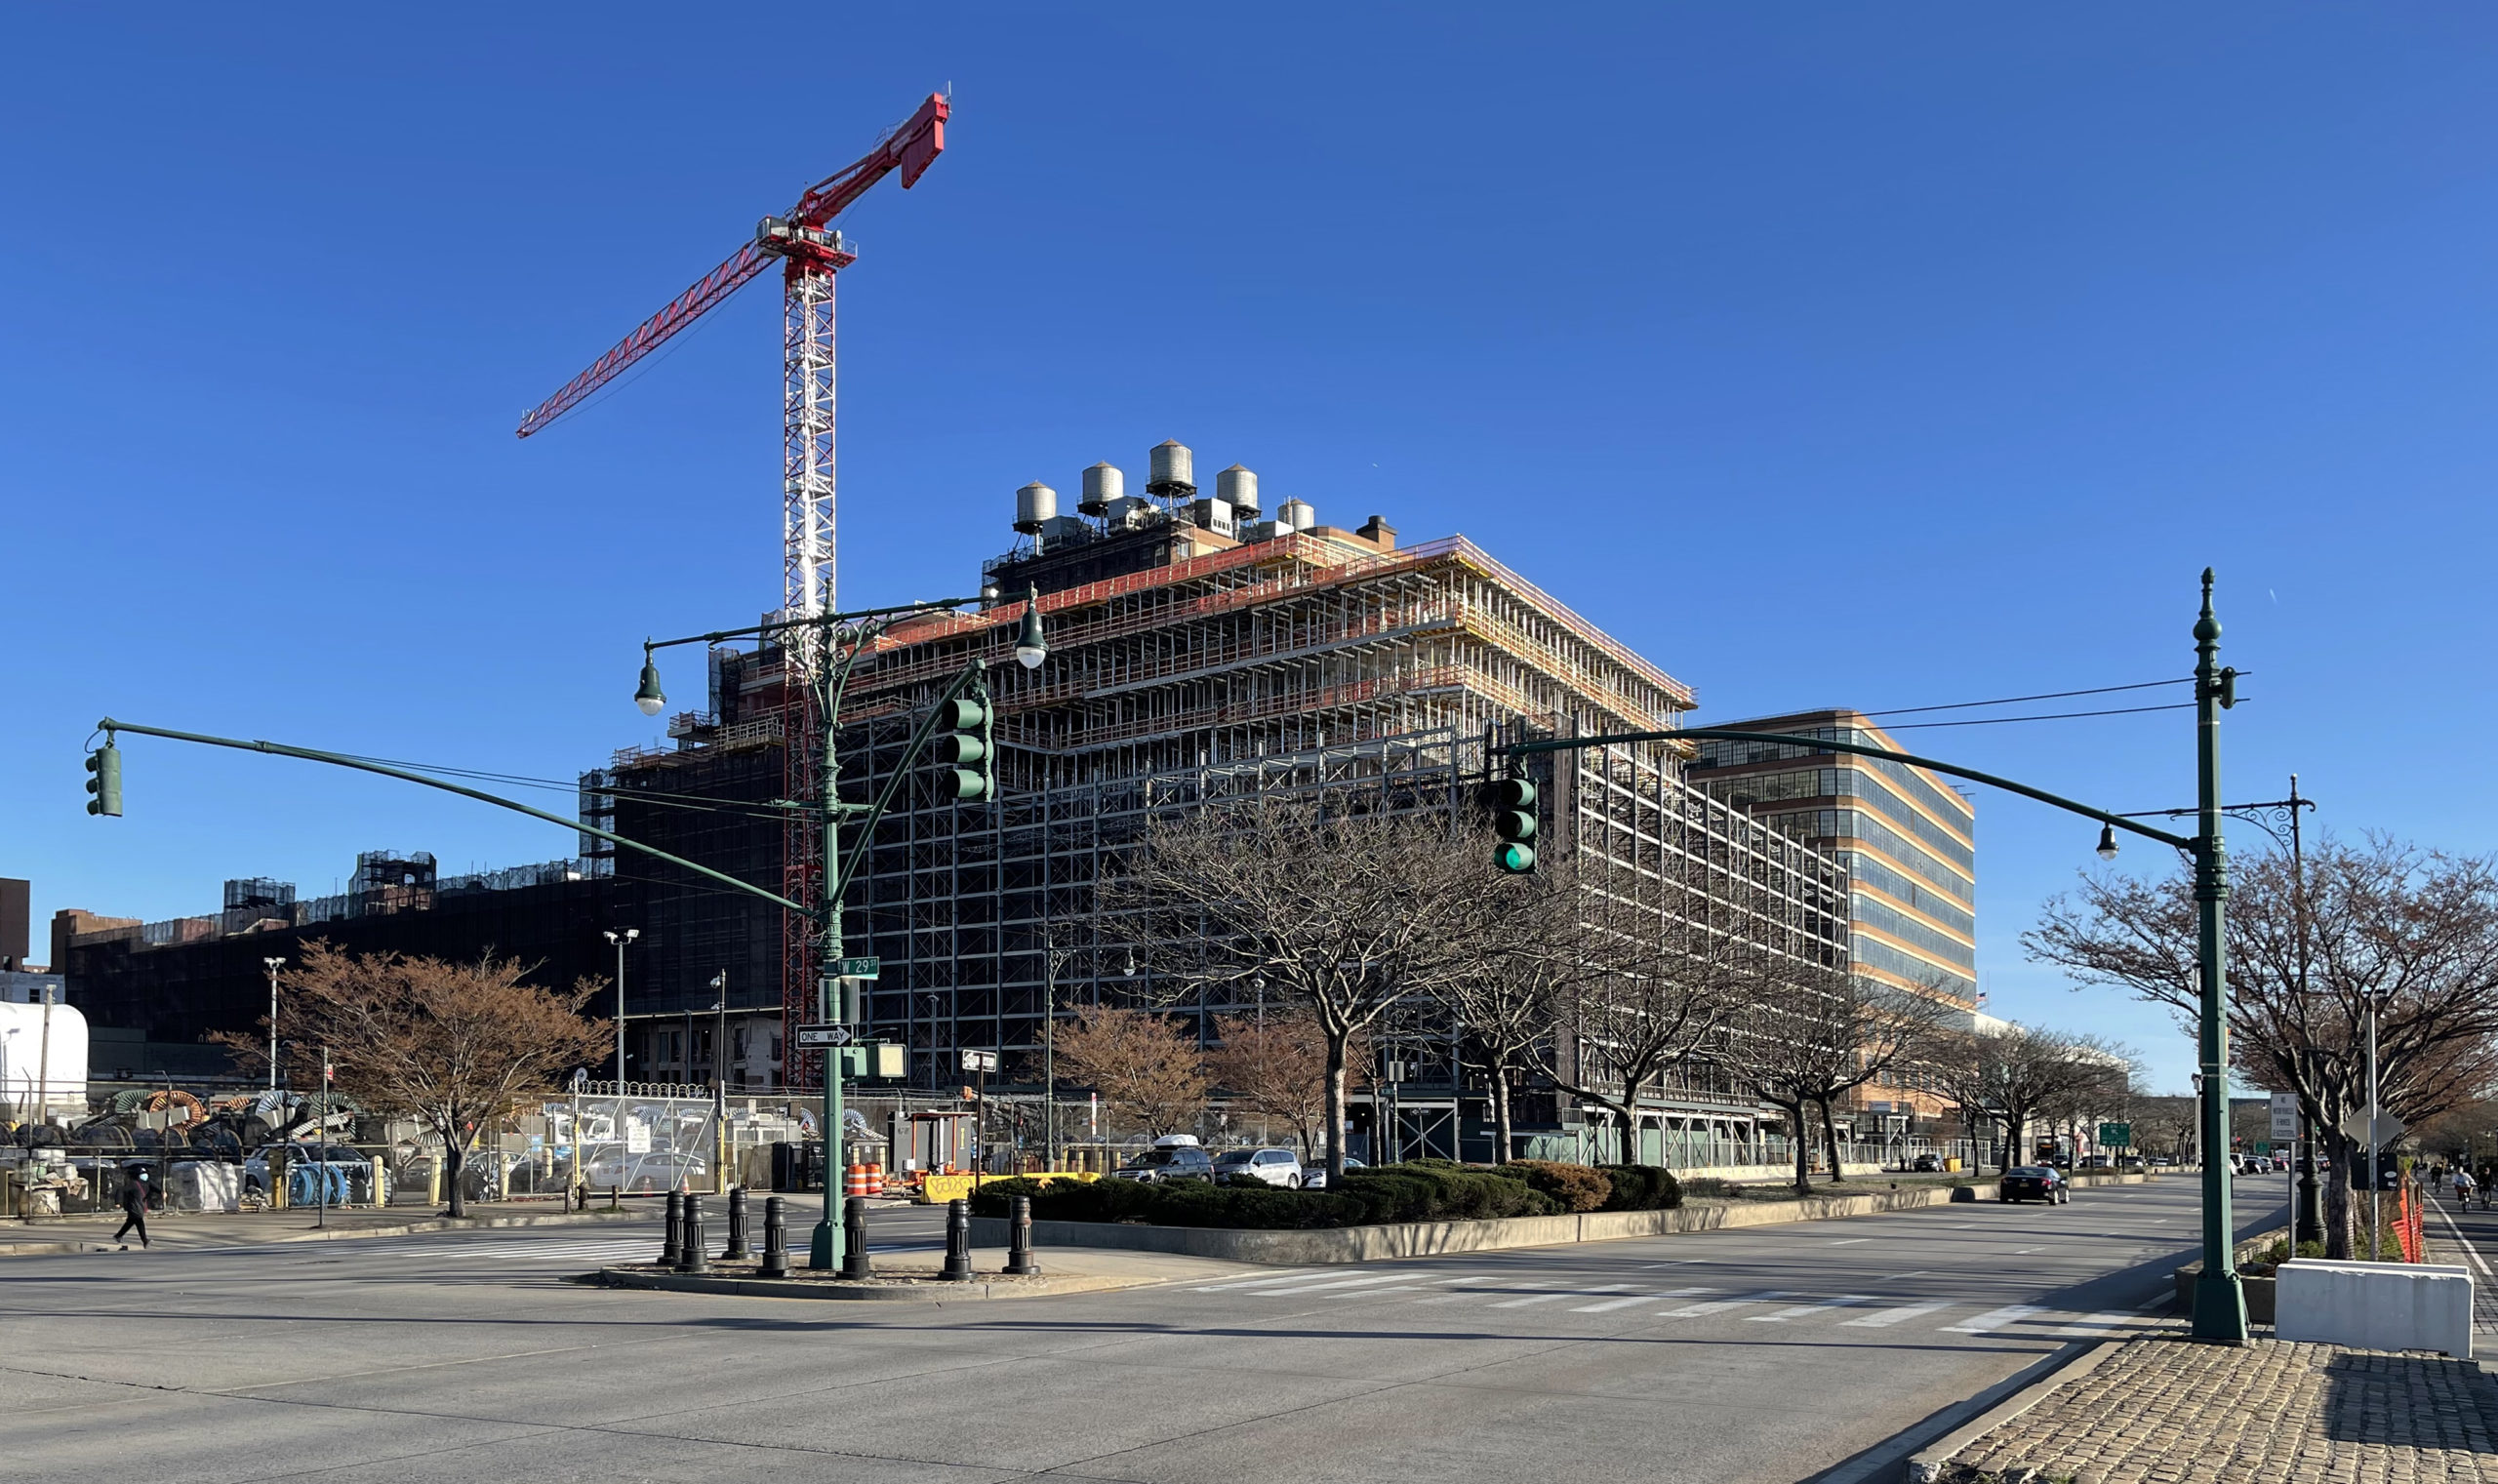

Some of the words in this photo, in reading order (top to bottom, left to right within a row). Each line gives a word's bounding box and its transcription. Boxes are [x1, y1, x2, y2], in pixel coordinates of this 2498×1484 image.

[842, 960, 850, 974] W
[855, 960, 868, 973] 29
[801, 1032, 818, 1041] ONE
[826, 1031, 845, 1041] WAY
